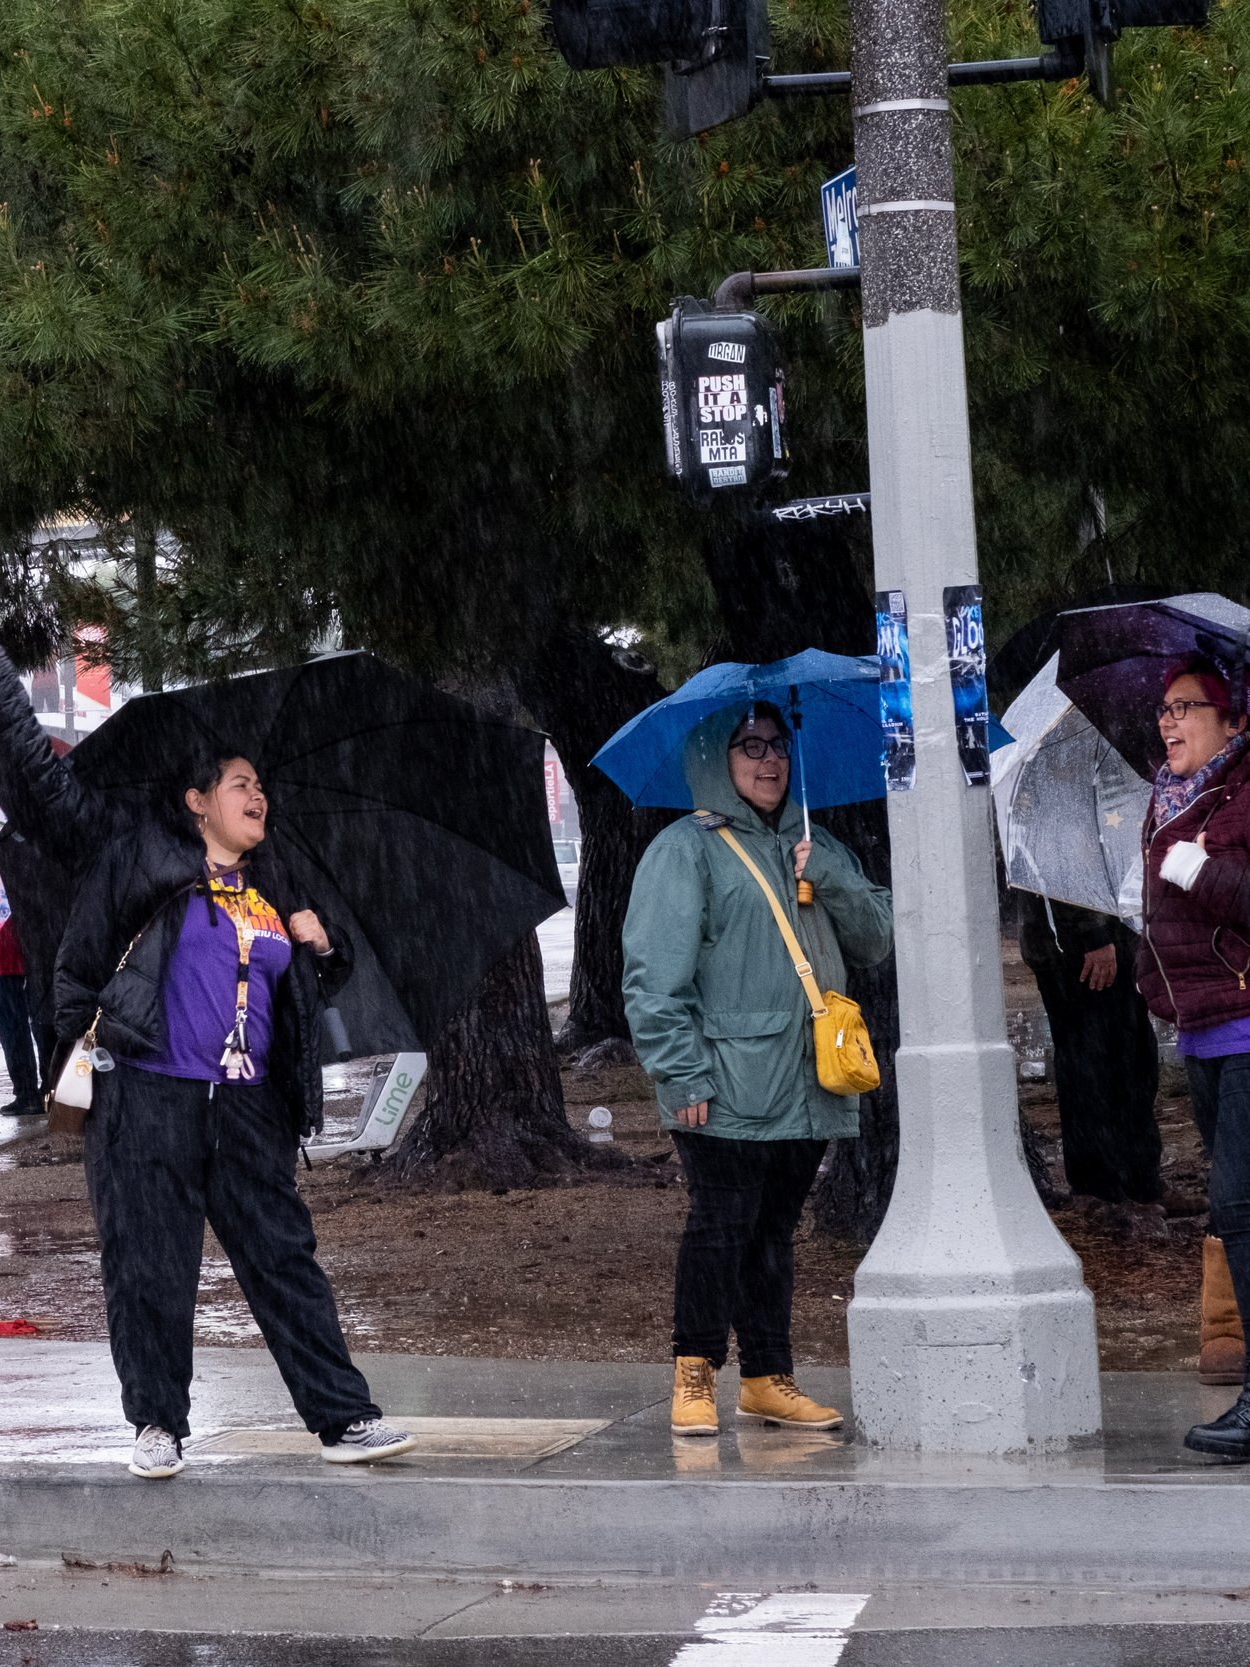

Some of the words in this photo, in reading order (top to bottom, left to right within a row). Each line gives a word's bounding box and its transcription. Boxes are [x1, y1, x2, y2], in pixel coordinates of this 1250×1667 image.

[699, 375, 744, 393] PUSH
[704, 393, 720, 406] IT
[730, 392, 742, 405] A
[700, 405, 746, 423] STOP
[709, 446, 738, 461] MTA
[375, 1072, 412, 1125] Lime
